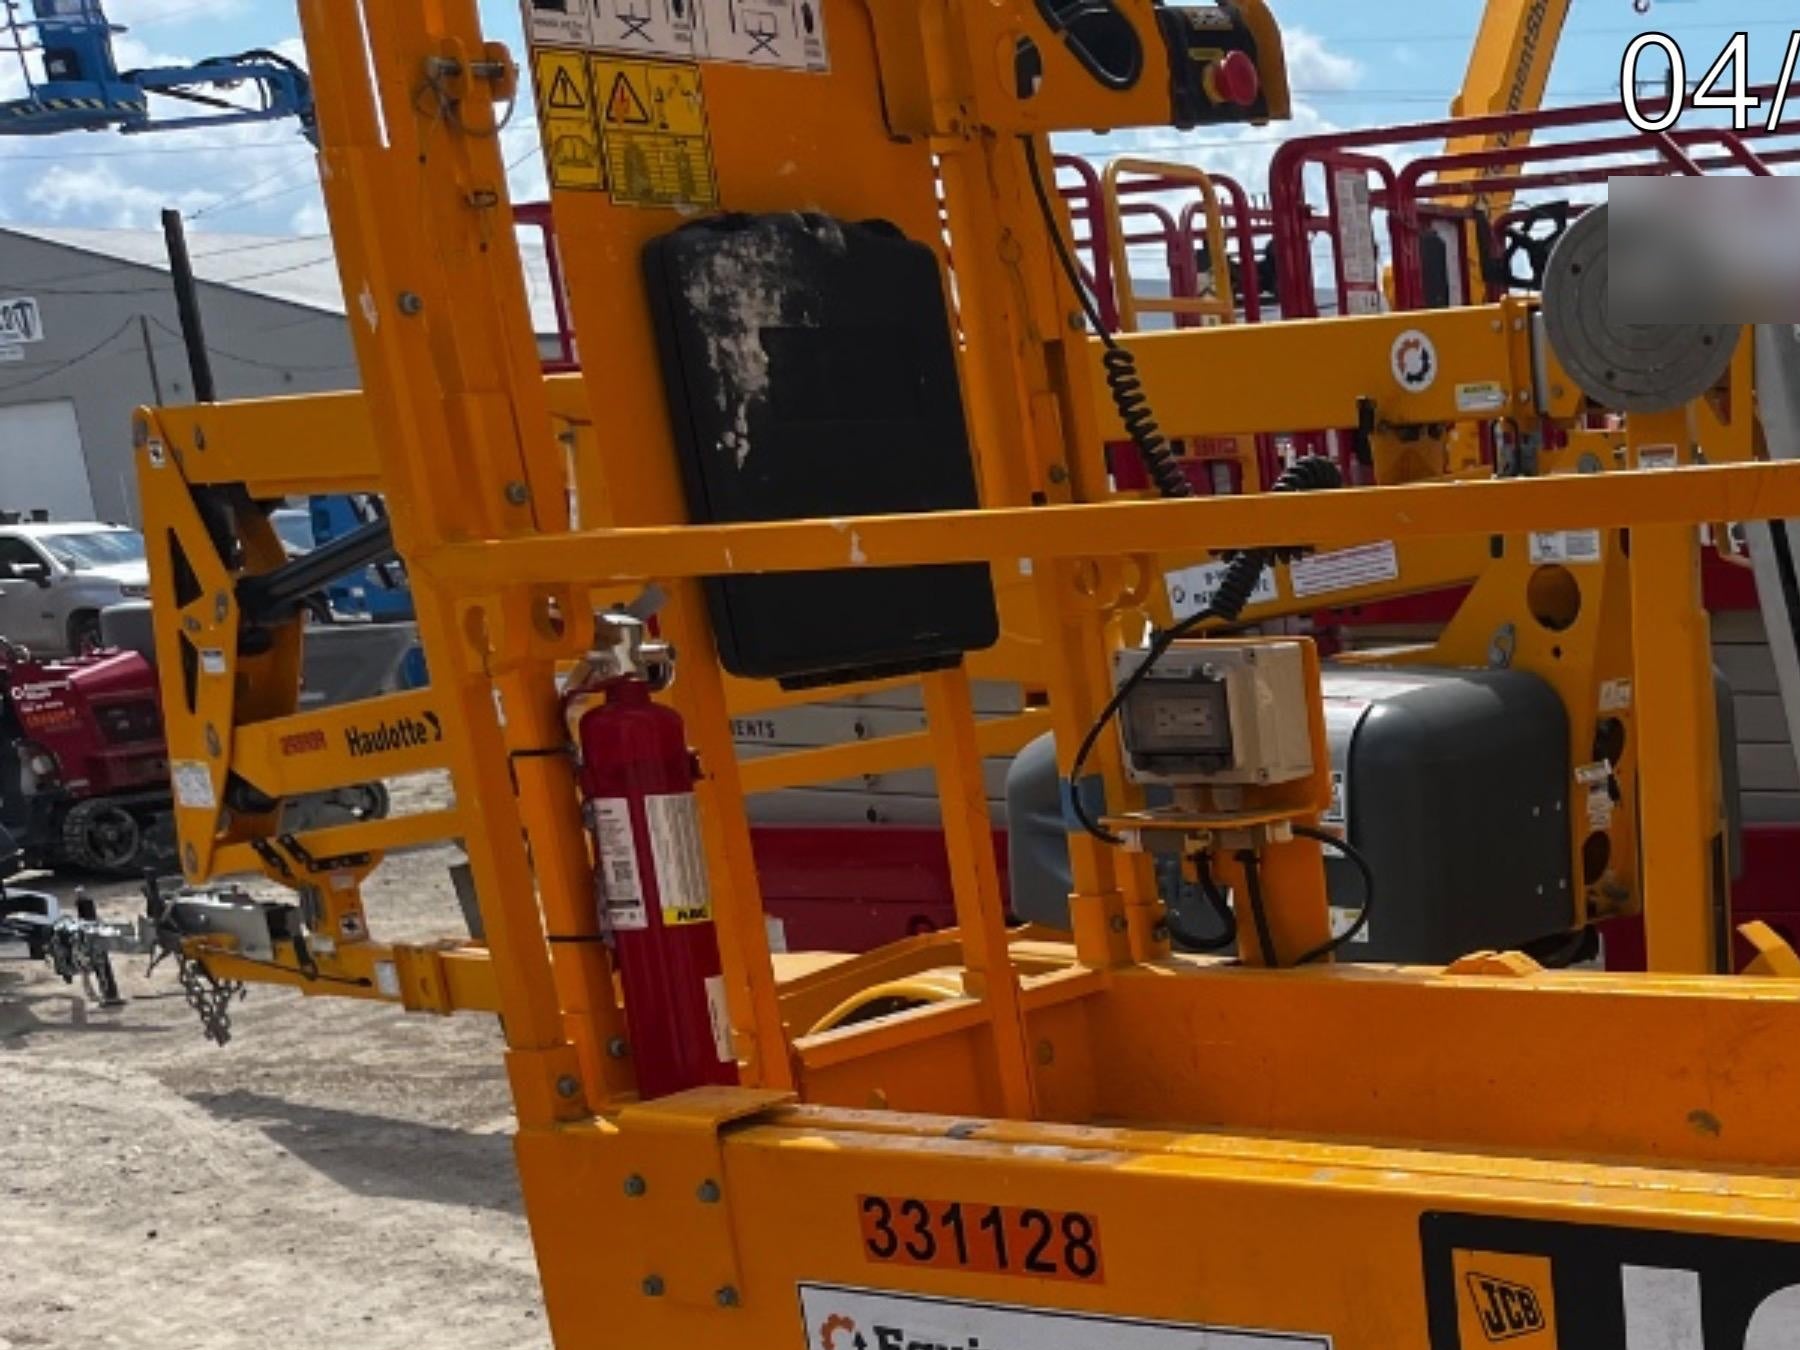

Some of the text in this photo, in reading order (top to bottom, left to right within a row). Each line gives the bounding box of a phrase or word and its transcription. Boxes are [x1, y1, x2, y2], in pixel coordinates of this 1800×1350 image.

[343, 715, 429, 757] Haulotte
[860, 1195, 1100, 1279] 331128
[1480, 1279, 1541, 1334] JCB
